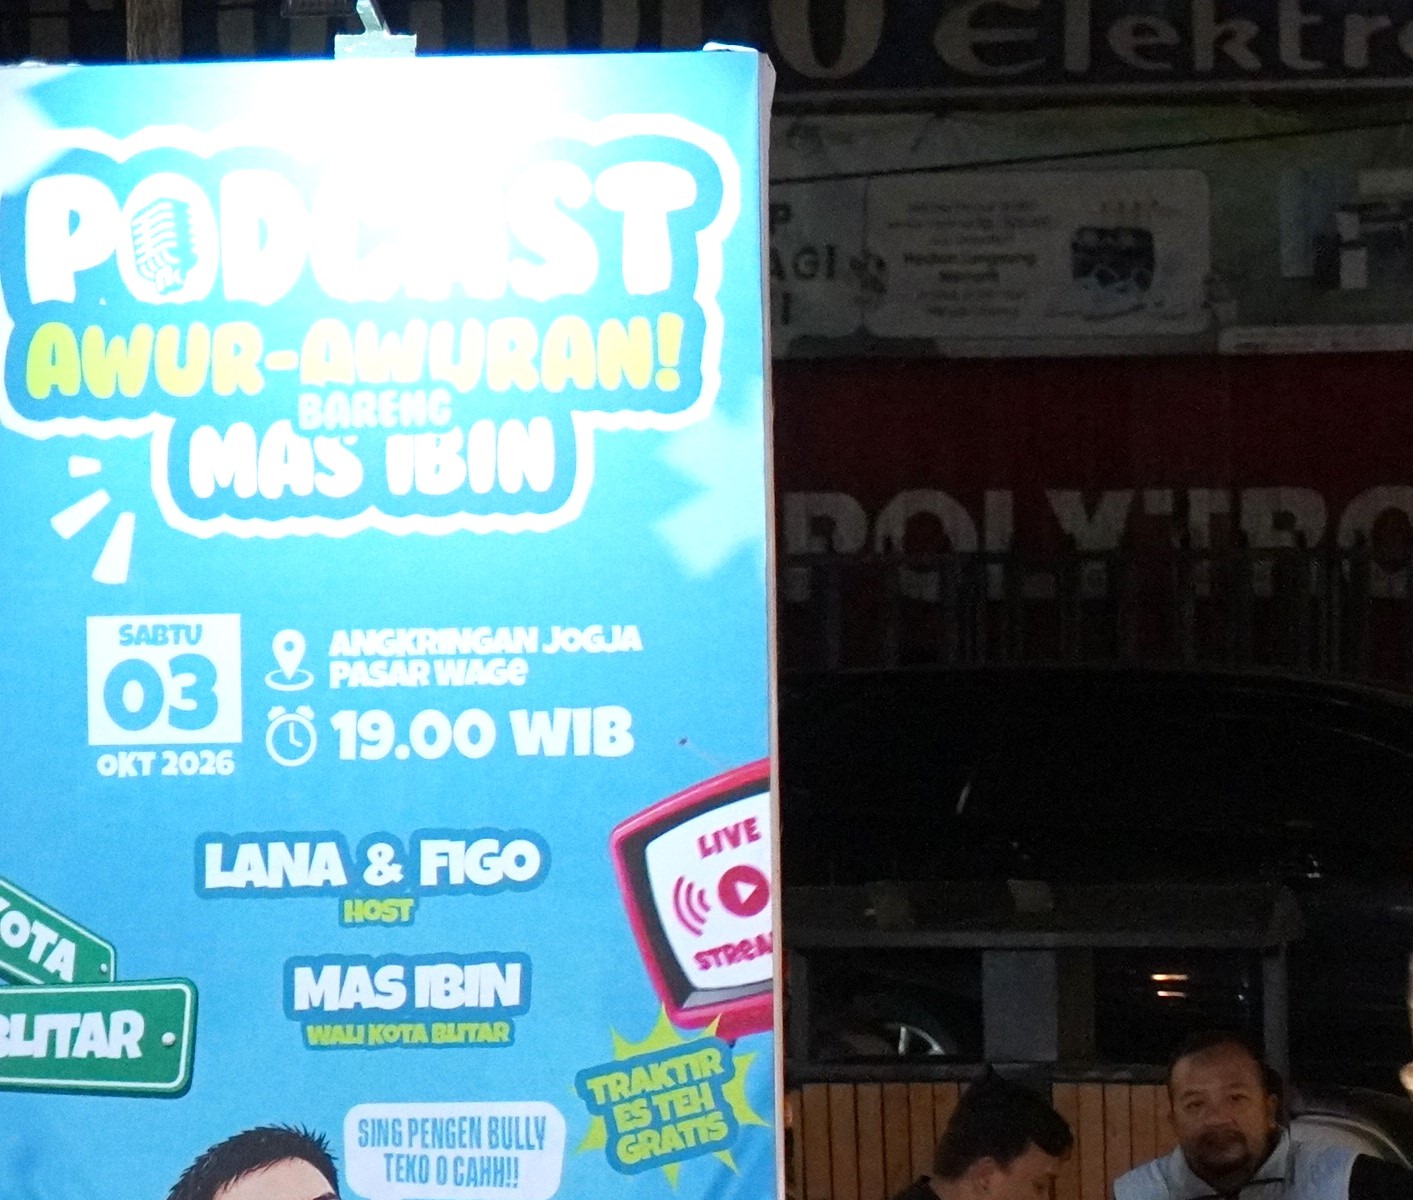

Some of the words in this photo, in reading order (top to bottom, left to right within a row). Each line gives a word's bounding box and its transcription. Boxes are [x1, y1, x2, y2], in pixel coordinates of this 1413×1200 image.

[26, 312, 684, 400] AWUR-AWURAN!
[298, 387, 452, 431] BARENG
[189, 420, 364, 499] MAS
[385, 417, 555, 496] IBIN
[118, 623, 203, 647] SABTU
[328, 625, 539, 657] ANGKRINGAN
[541, 624, 644, 655] JOGJA
[103, 653, 219, 732] 03
[329, 658, 431, 689] PASAR
[330, 707, 497, 761] 19.00
[508, 705, 635, 758] WIB
[96, 751, 156, 778] OKT
[161, 749, 236, 777] 2026
[697, 816, 762, 858] LIVE
[204, 841, 348, 888] LANA
[362, 842, 404, 887] &
[419, 838, 541, 887] FIGO
[343, 898, 415, 923] HOST
[0, 897, 76, 983] OTA
[294, 964, 407, 1011] MAS
[413, 962, 522, 1010] IBIN
[306, 1024, 364, 1045] WALI
[367, 1023, 429, 1045] KOTA
[431, 1021, 511, 1044] BLITAR
[587, 1047, 724, 1105] TRAKTIR
[615, 1099, 650, 1133] ES
[654, 1083, 715, 1126] TEH
[357, 1118, 402, 1148] SING
[407, 1116, 482, 1150] PENGEN
[487, 1115, 547, 1151] BULLY
[616, 1112, 729, 1165] GRATIS
[383, 1153, 430, 1184] TEKO
[436, 1155, 448, 1186] O
